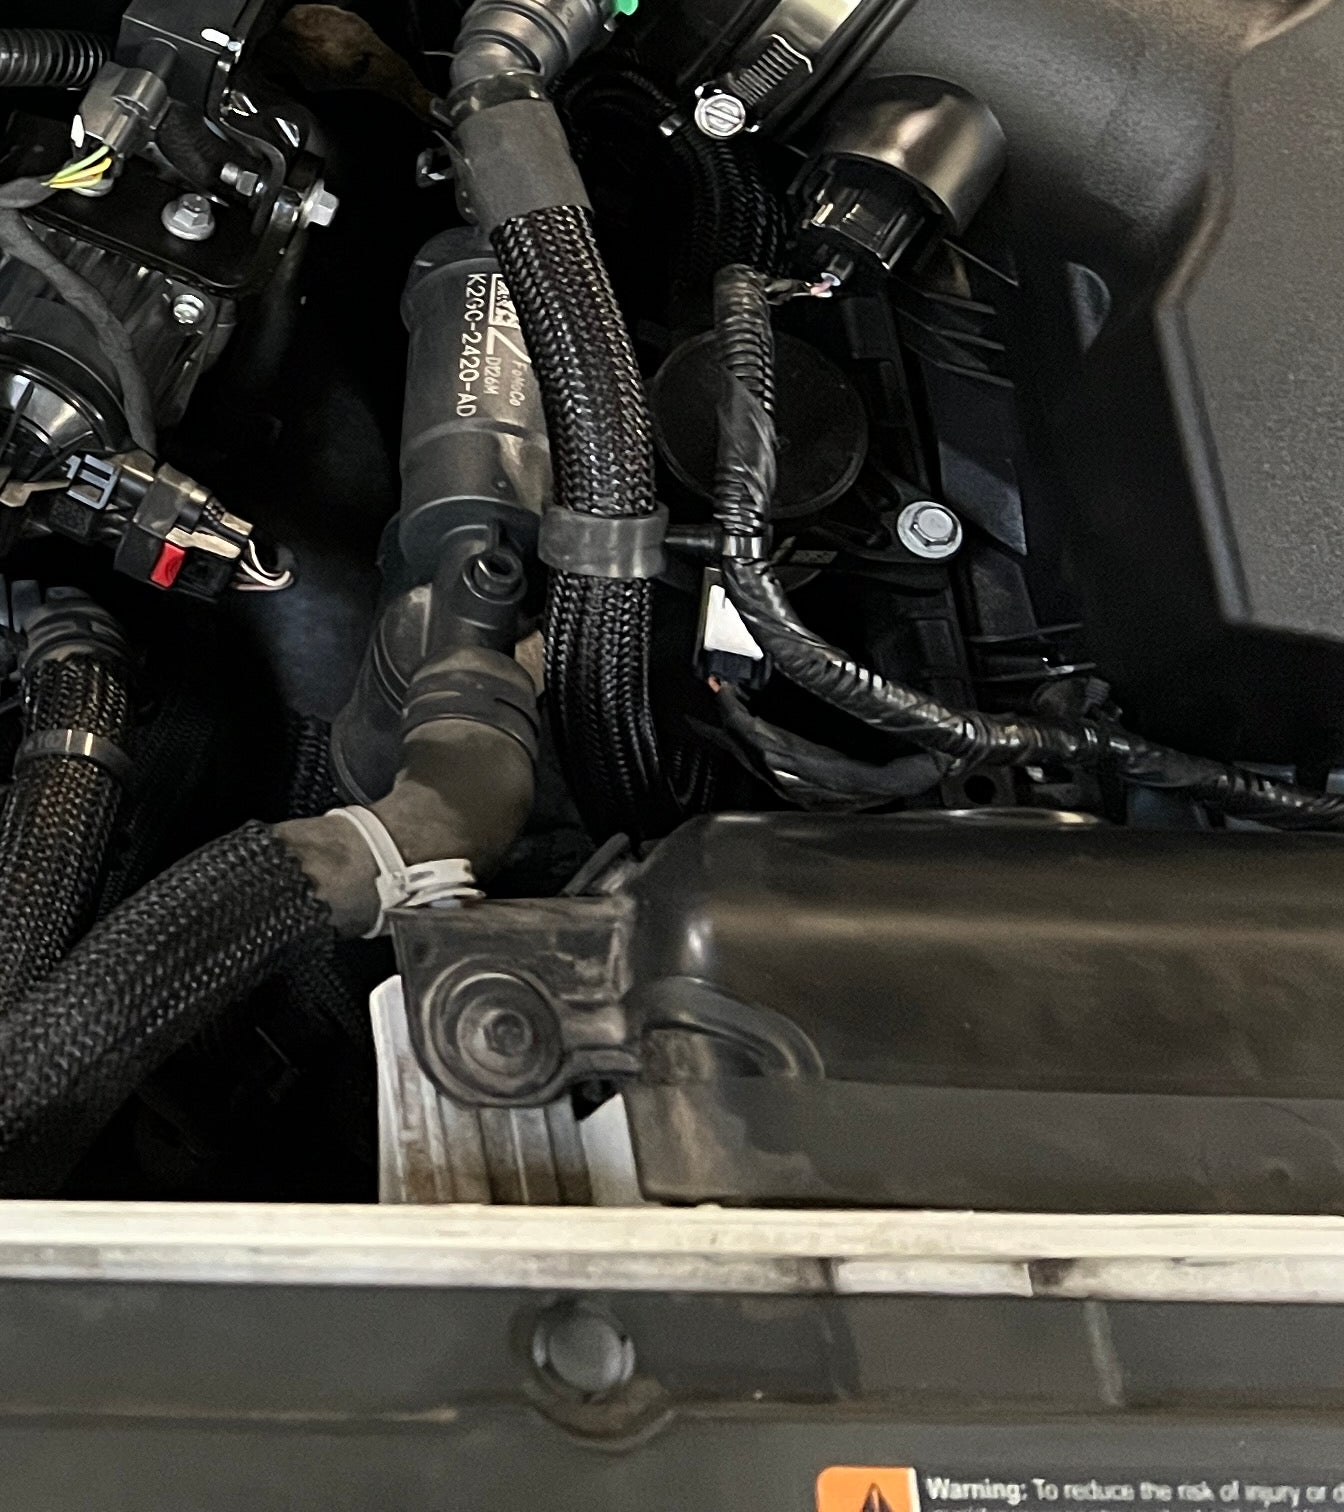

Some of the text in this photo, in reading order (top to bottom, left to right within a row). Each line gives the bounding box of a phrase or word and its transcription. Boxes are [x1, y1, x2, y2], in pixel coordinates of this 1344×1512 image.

[509, 359, 529, 408] FoMoCo
[926, 1477, 1027, 1506] Warning:
[1032, 1479, 1058, 1500] To
[1064, 1481, 1135, 1502] reduce
[1140, 1481, 1171, 1502] the
[1178, 1481, 1212, 1502] risk
[1220, 1480, 1240, 1502] of
[1244, 1483, 1300, 1507] injury
[1306, 1486, 1326, 1503] or
